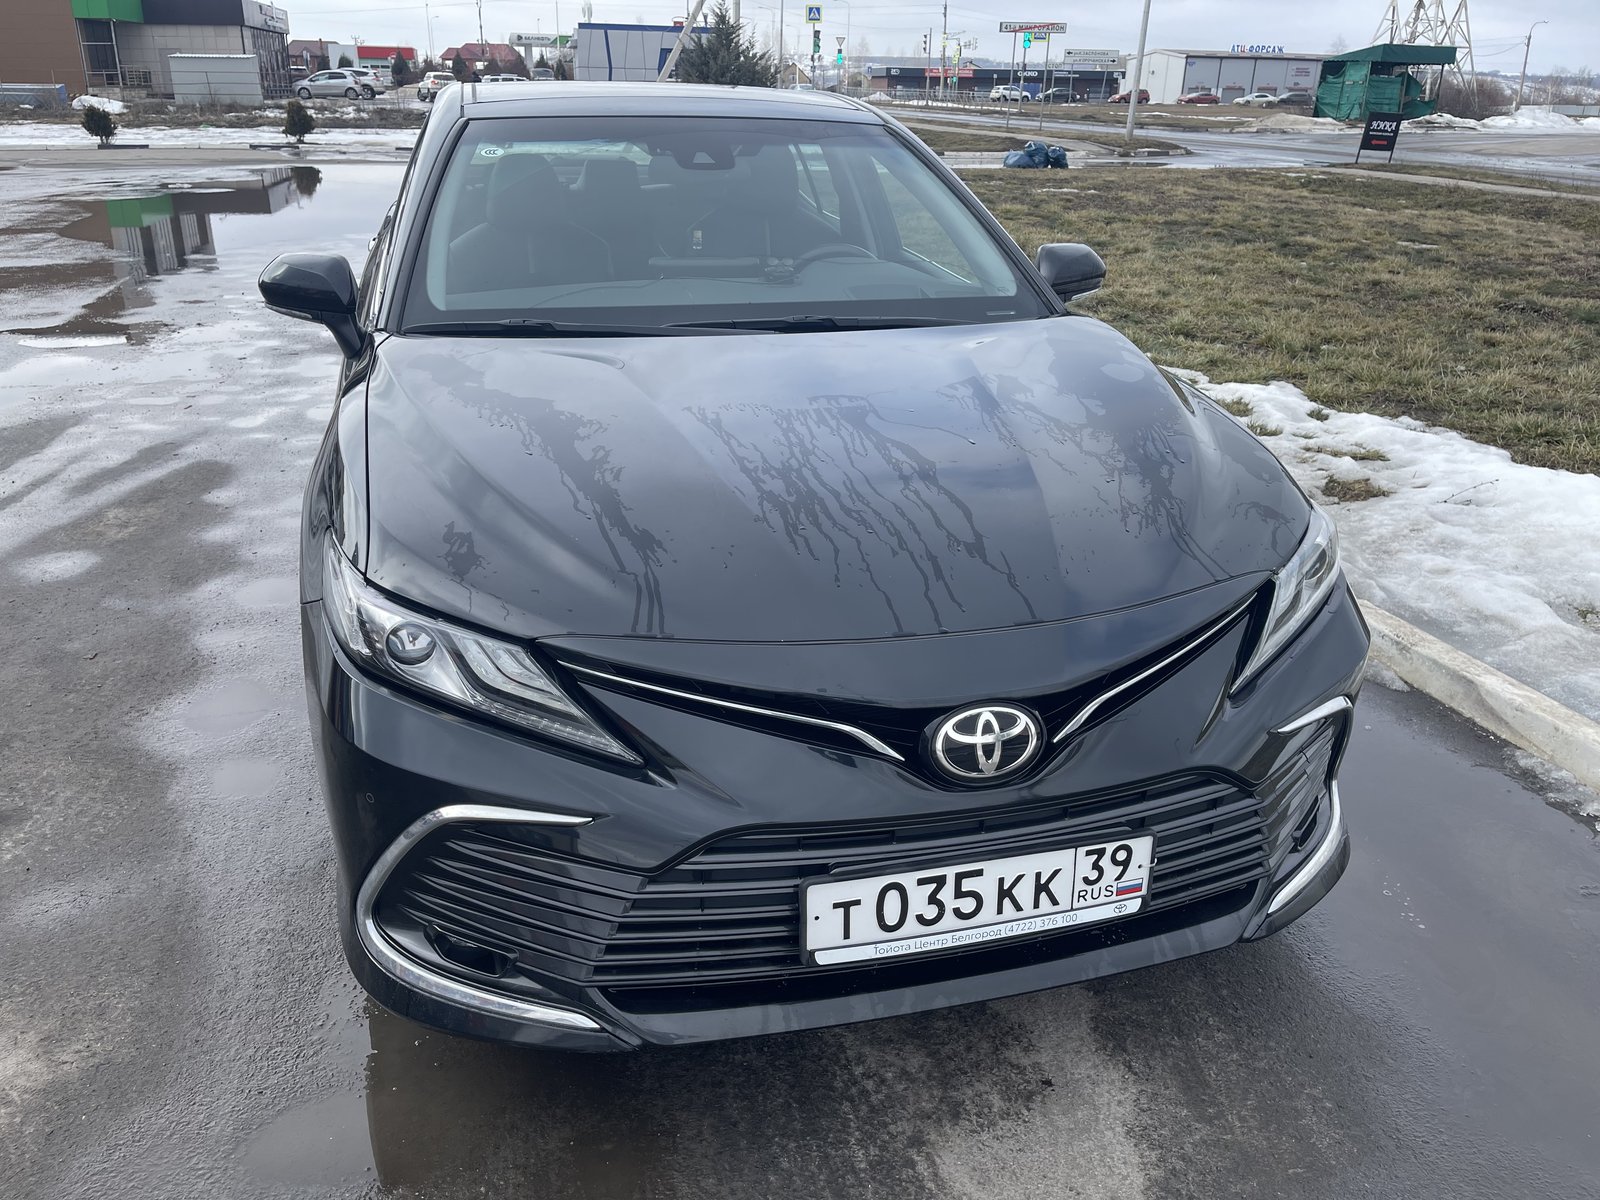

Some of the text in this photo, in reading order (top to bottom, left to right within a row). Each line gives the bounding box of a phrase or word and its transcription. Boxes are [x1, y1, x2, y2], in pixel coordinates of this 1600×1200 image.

[1018, 24, 1065, 32] МИКРОРАЙОН
[1230, 44, 1285, 54] АТЦ-ФОРСАЖ
[1370, 120, 1397, 132] НИКА
[1082, 843, 1134, 886] 39
[1077, 884, 1114, 903] RUS
[874, 912, 1078, 955] Тойота Центр Белгород (4722) 376 100
